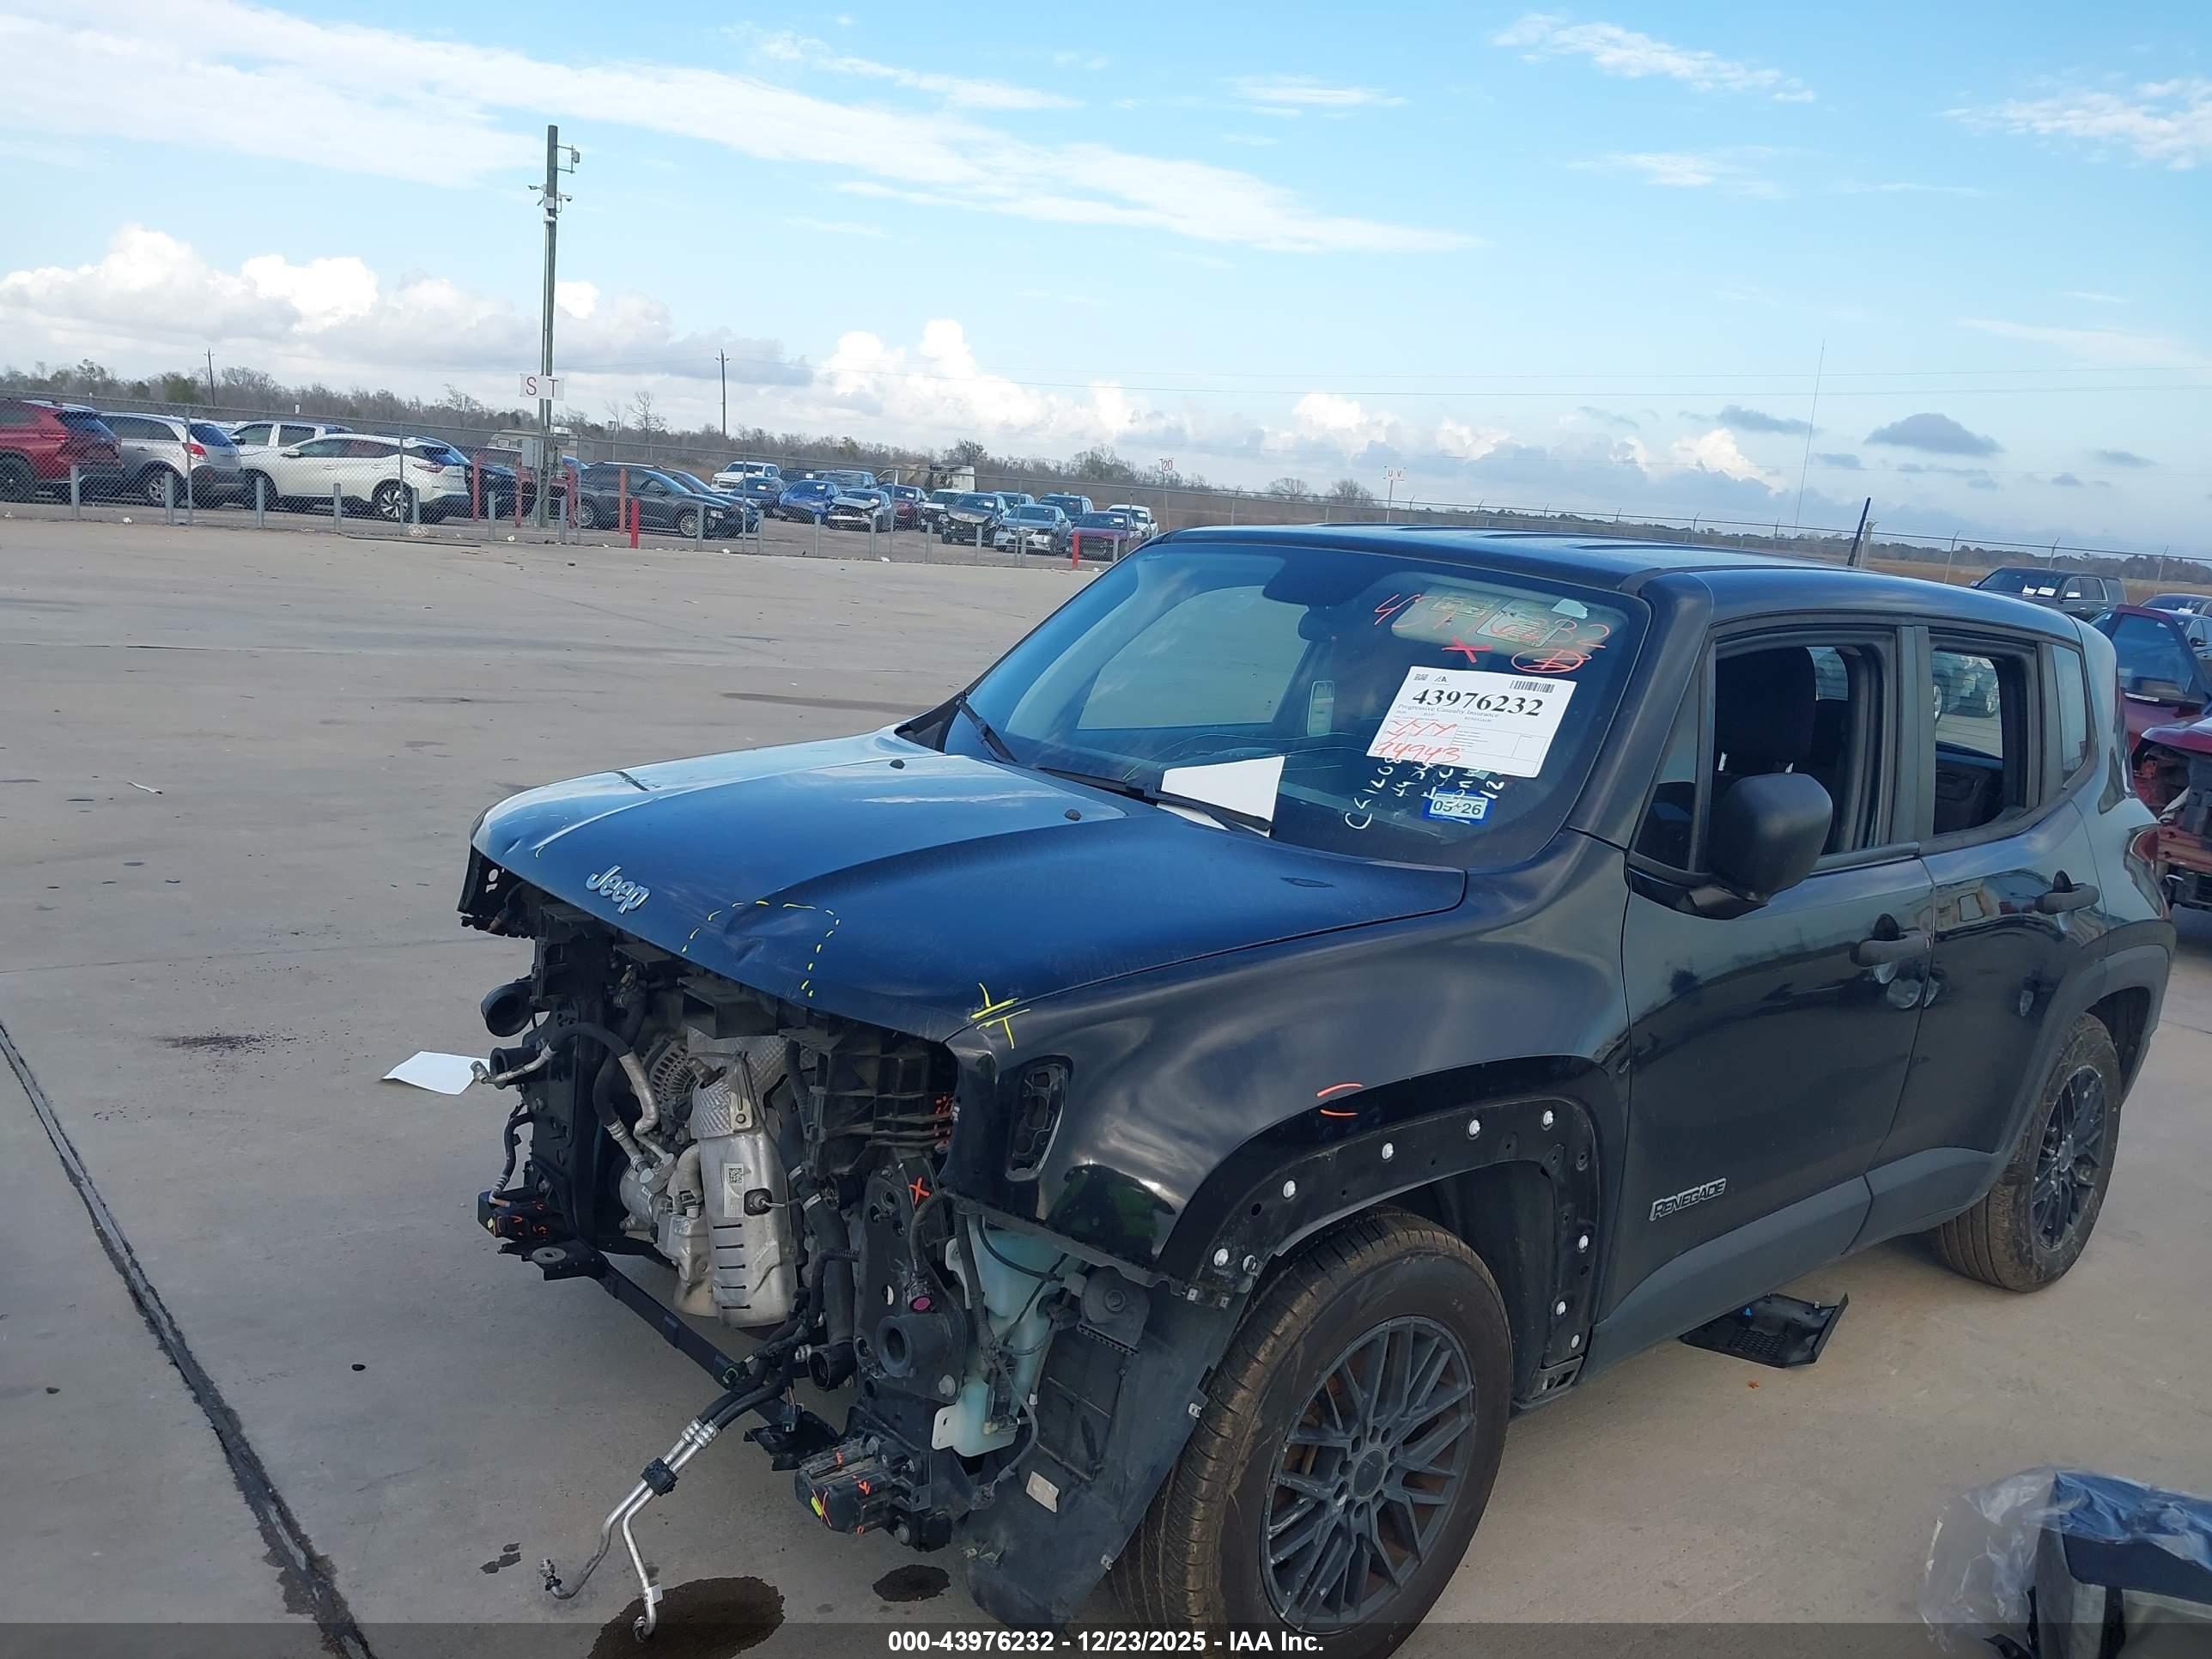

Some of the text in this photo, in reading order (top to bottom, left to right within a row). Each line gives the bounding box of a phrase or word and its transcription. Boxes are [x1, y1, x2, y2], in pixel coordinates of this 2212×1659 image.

[526, 376, 559, 398] S T
[1397, 703, 1436, 713] Progressive
[1436, 706, 1464, 715] Casualty
[1467, 709, 1499, 718] Insurance
[1413, 689, 1543, 716] 43976232
[1433, 800, 1482, 816] 05 26
[586, 865, 651, 914] Jeep
[1649, 1177, 1726, 1221] RENEGADE
